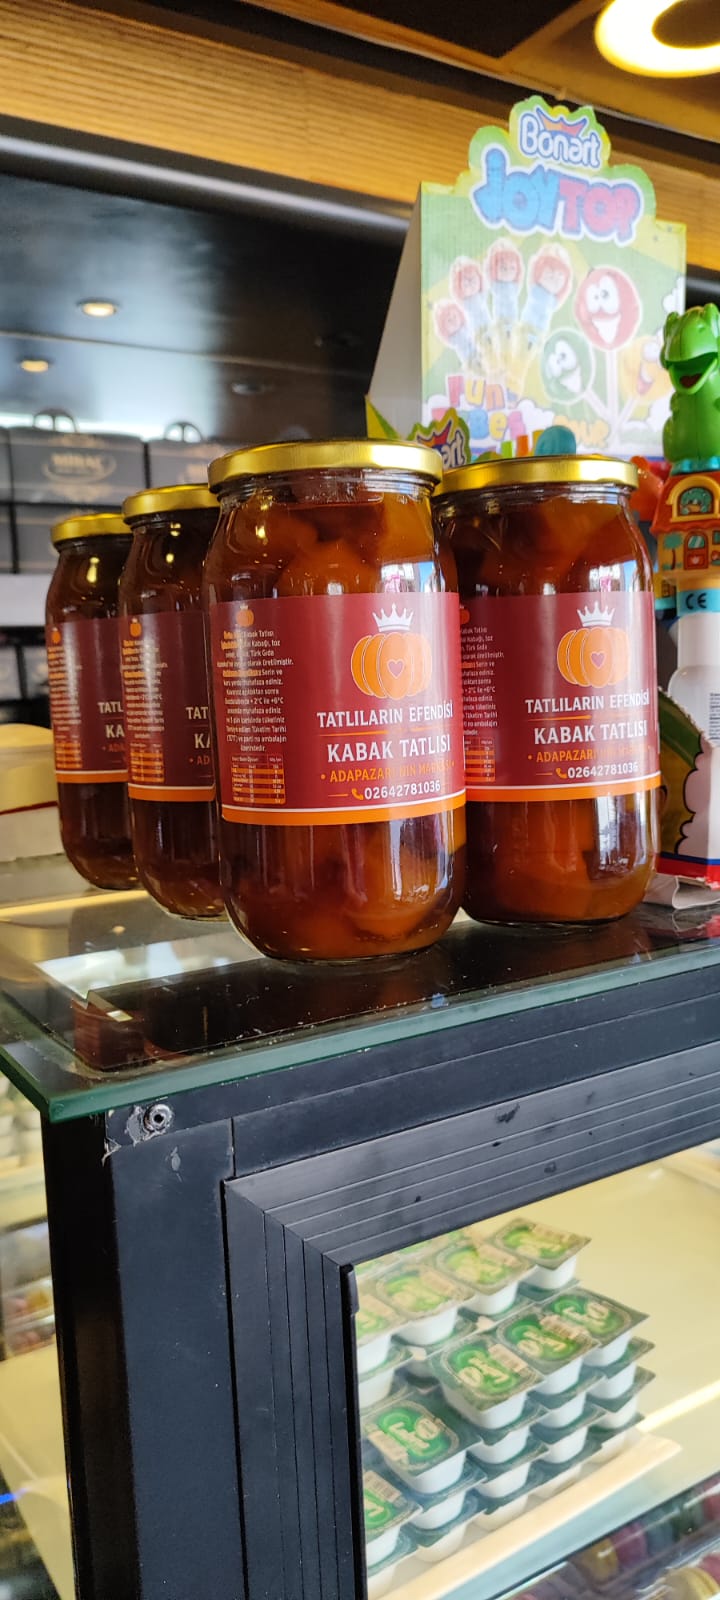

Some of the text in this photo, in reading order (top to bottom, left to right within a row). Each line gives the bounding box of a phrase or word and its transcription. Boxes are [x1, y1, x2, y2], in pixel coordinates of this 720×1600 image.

[520, 112, 600, 168] Bonart
[525, 696, 604, 714] TATLILARIN
[317, 708, 403, 728] TATLILARIN
[534, 720, 648, 745] KABAK TATLISI
[327, 734, 450, 763] KABAK TATLISI
[364, 780, 441, 800] 02642781036
